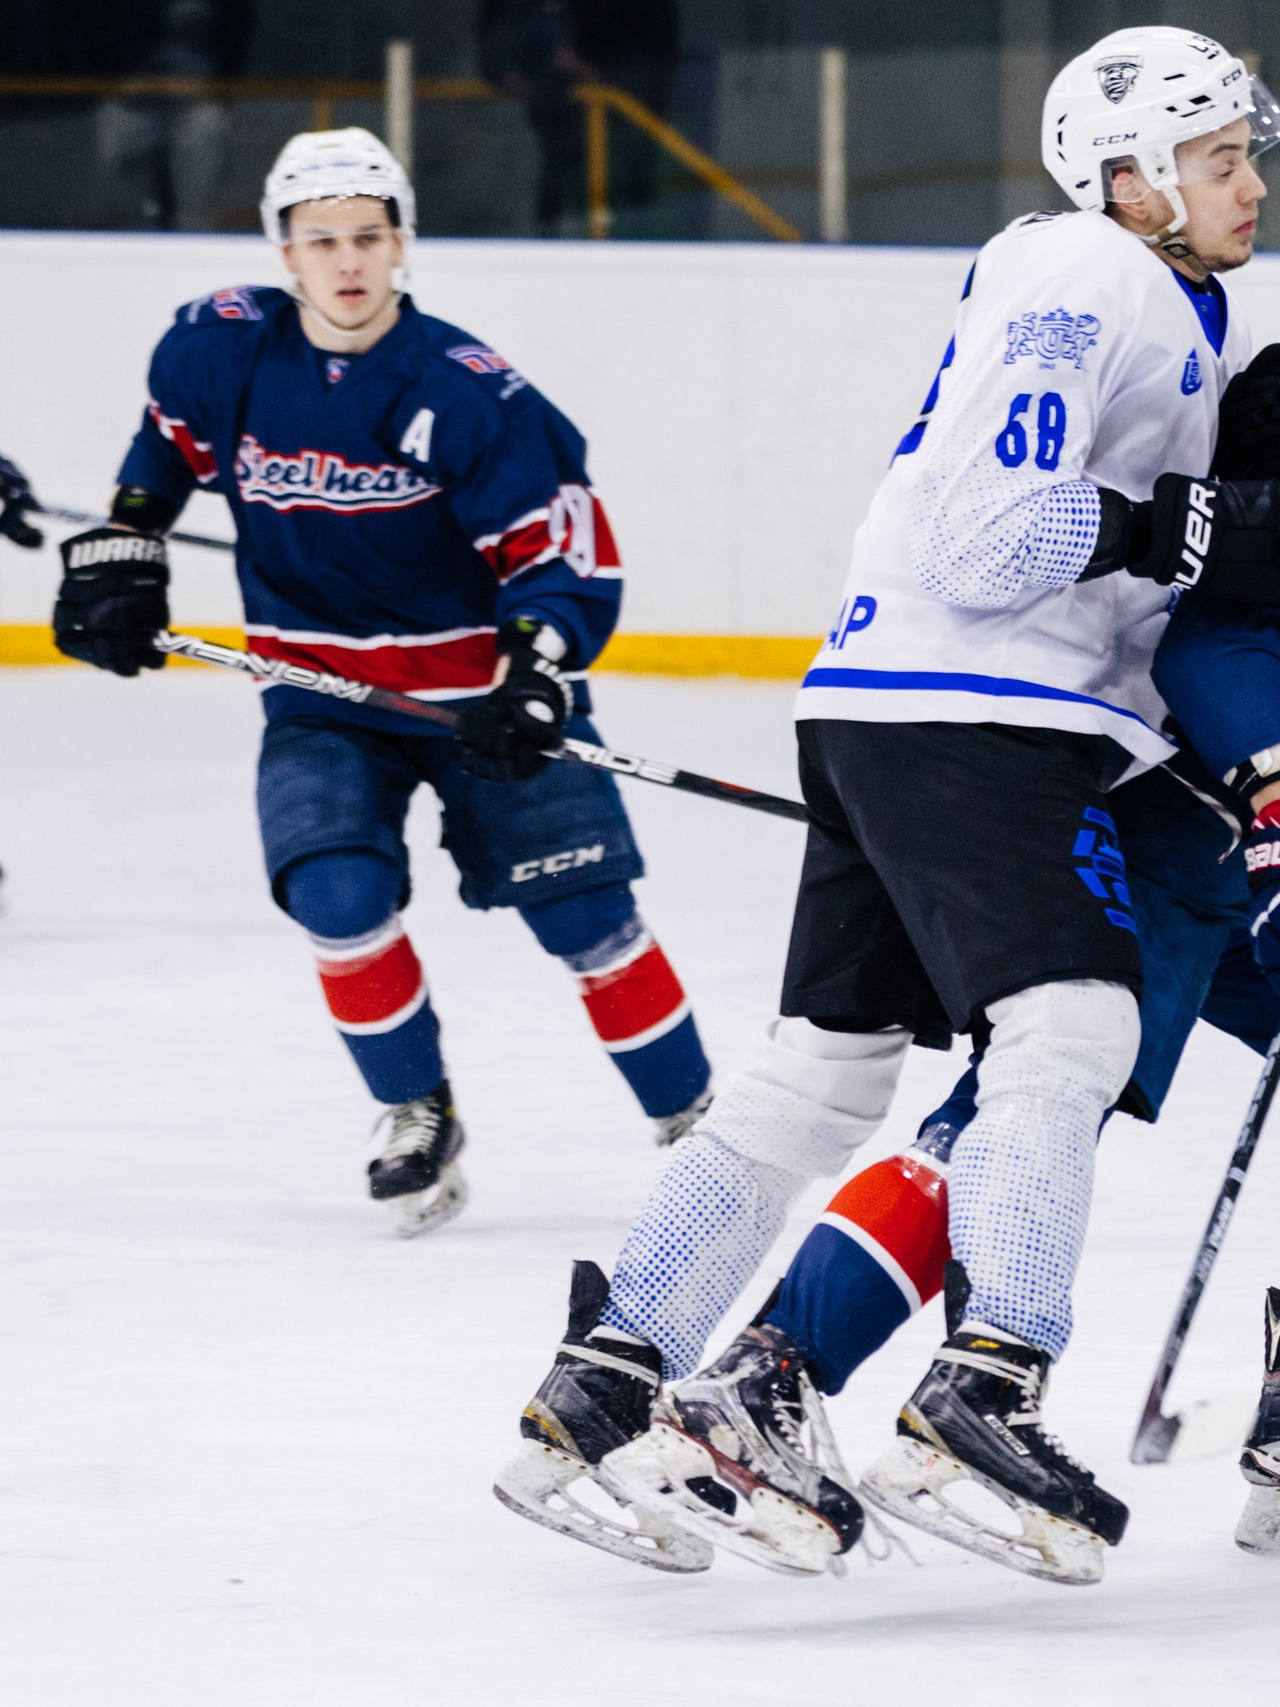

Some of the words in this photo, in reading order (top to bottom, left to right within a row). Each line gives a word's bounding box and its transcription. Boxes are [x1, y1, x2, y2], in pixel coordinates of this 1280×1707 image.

[1092, 132, 1138, 146] CCM
[400, 408, 435, 463] A
[995, 392, 1067, 472] 68
[511, 845, 605, 883] CCM
